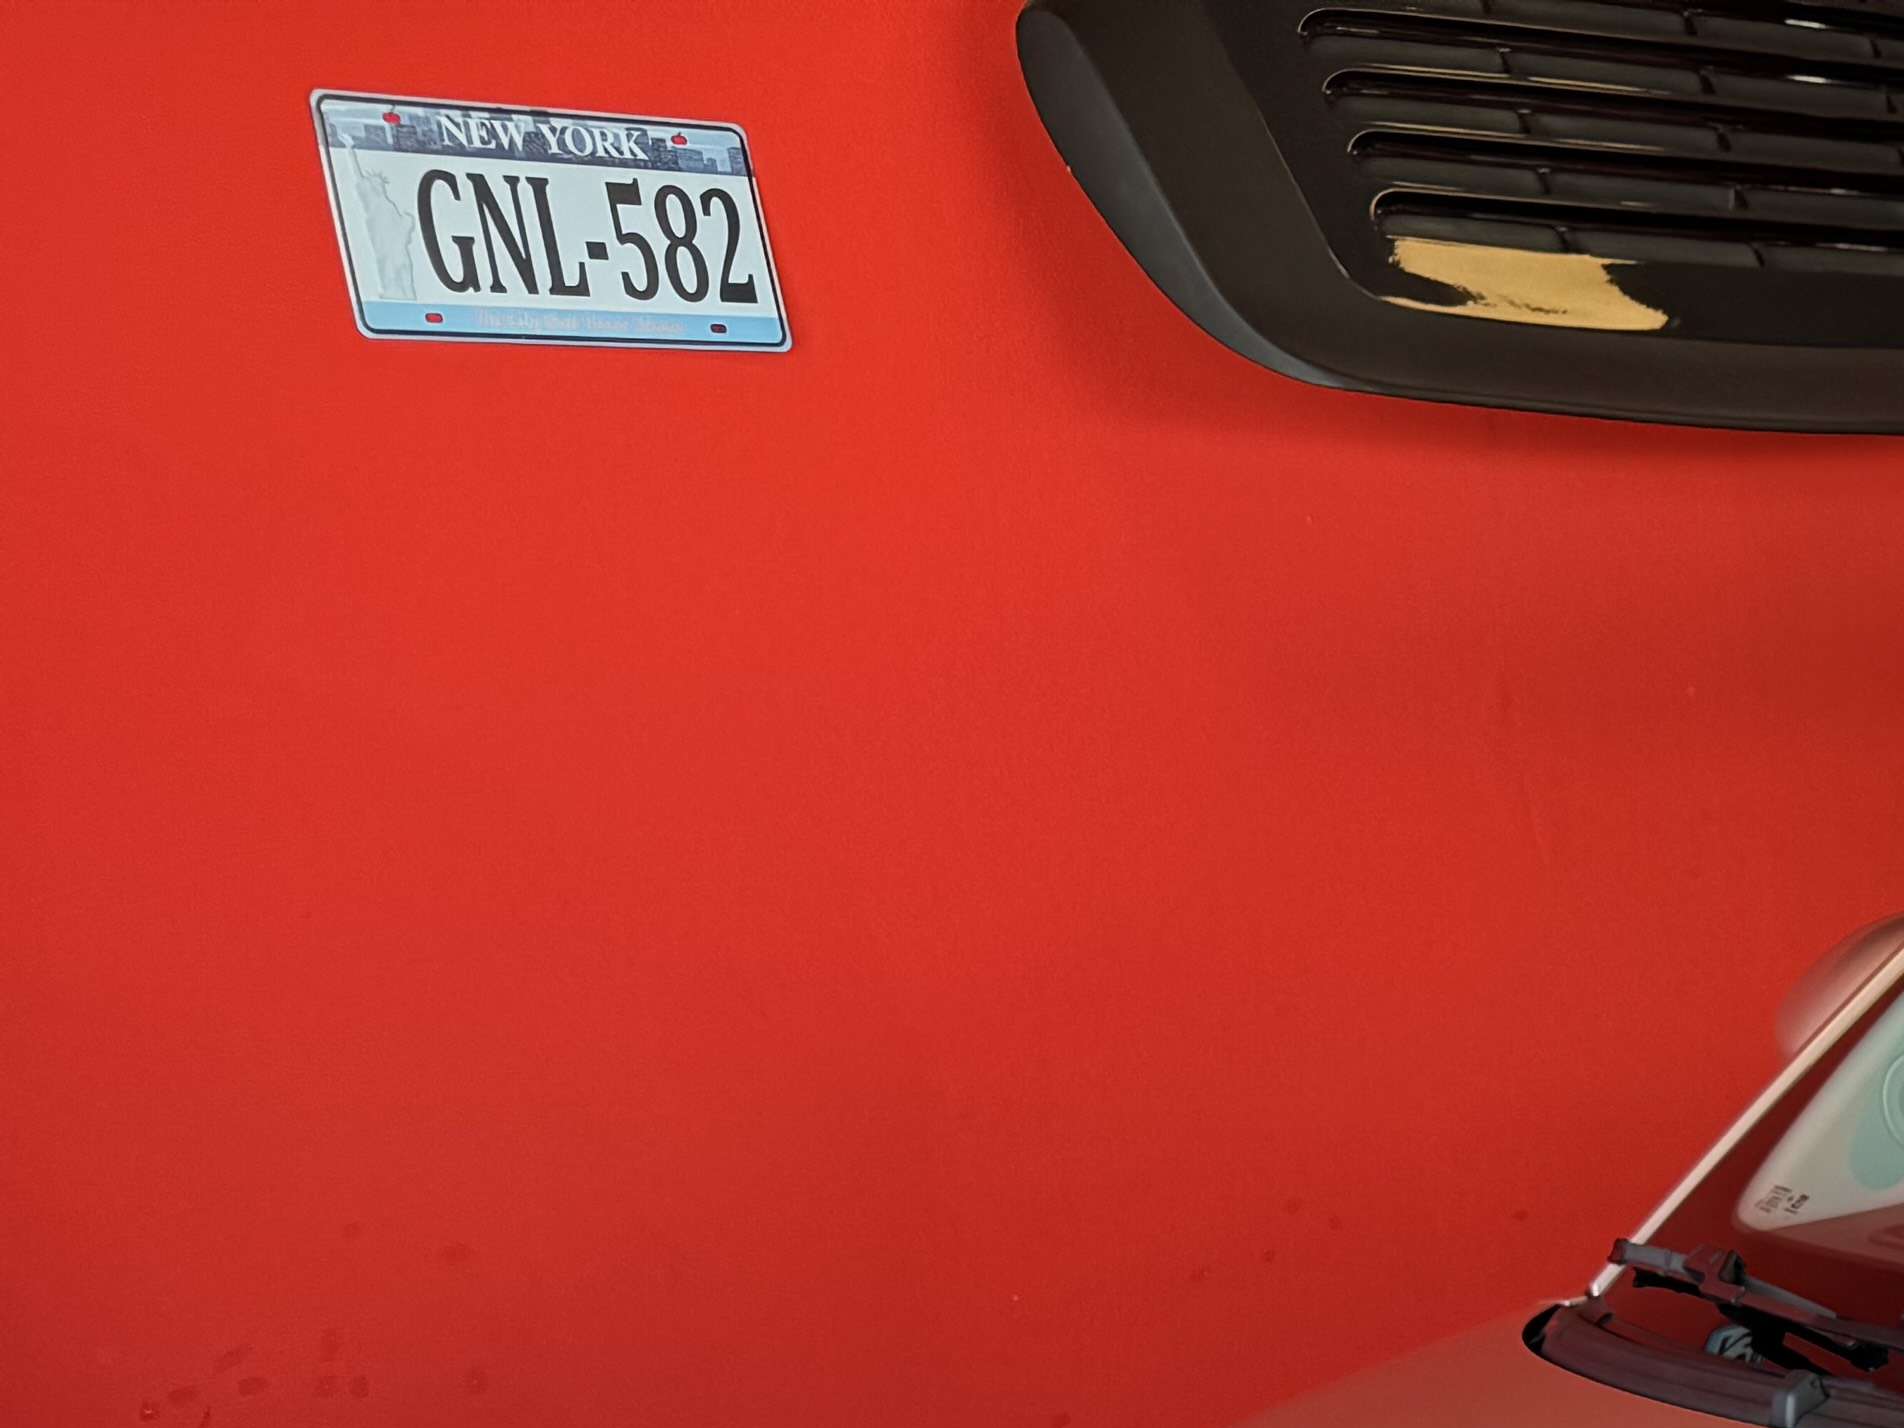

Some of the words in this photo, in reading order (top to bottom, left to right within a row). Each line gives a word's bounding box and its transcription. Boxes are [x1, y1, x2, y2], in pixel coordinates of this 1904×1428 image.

[440, 114, 527, 152] NEW
[538, 122, 651, 161] YORK
[417, 168, 759, 305] GNL-582
